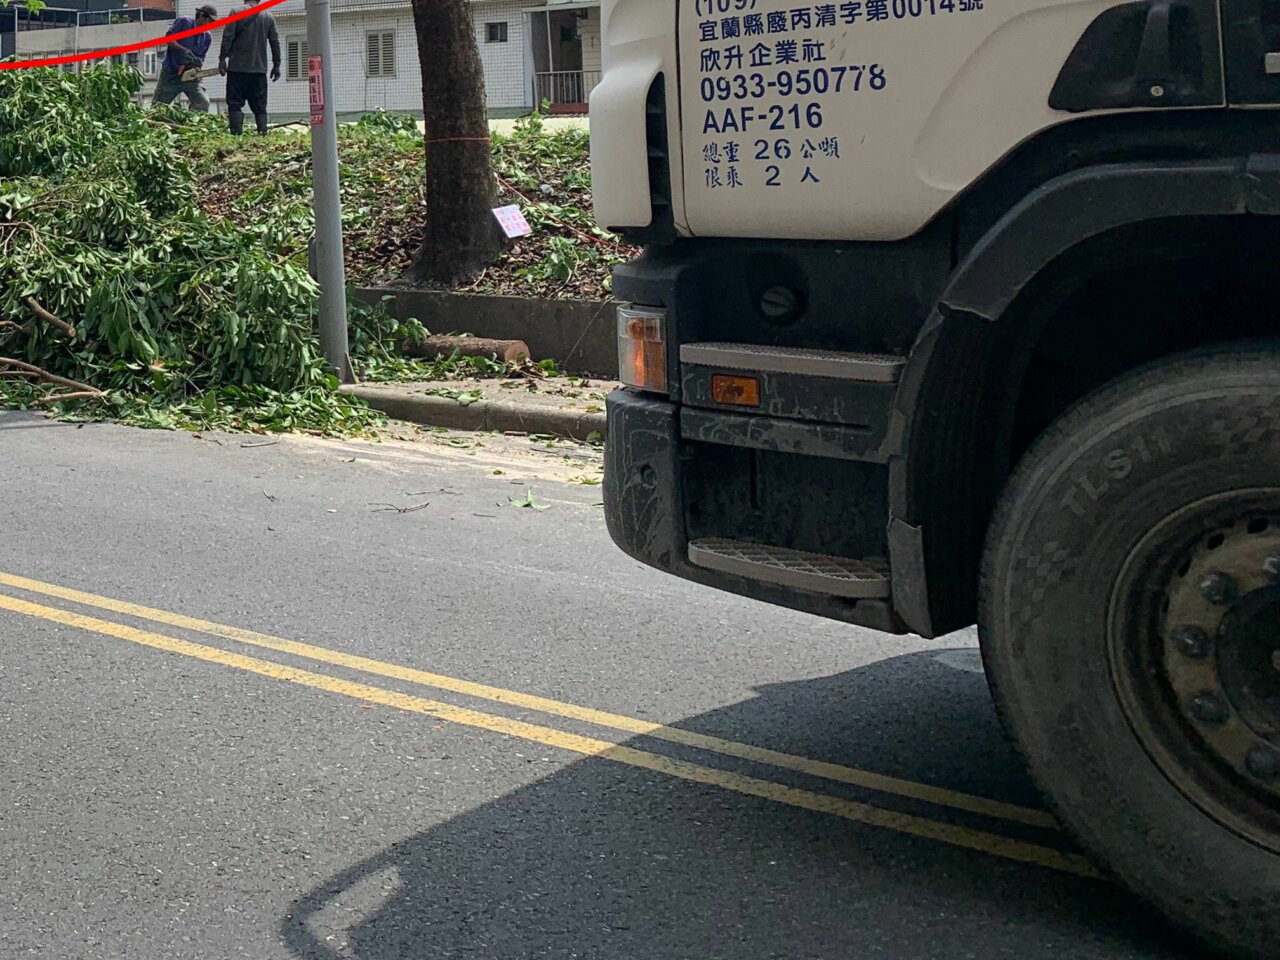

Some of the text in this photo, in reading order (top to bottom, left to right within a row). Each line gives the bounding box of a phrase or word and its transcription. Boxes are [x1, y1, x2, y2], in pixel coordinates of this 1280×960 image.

[700, 39, 826, 72] 欣升企業社
[700, 64, 886, 102] 0933-950778
[703, 102, 823, 133] AAF-216
[702, 141, 740, 163] 總重
[754, 138, 792, 160] 26
[765, 165, 782, 186] 2
[800, 166, 820, 184] 人
